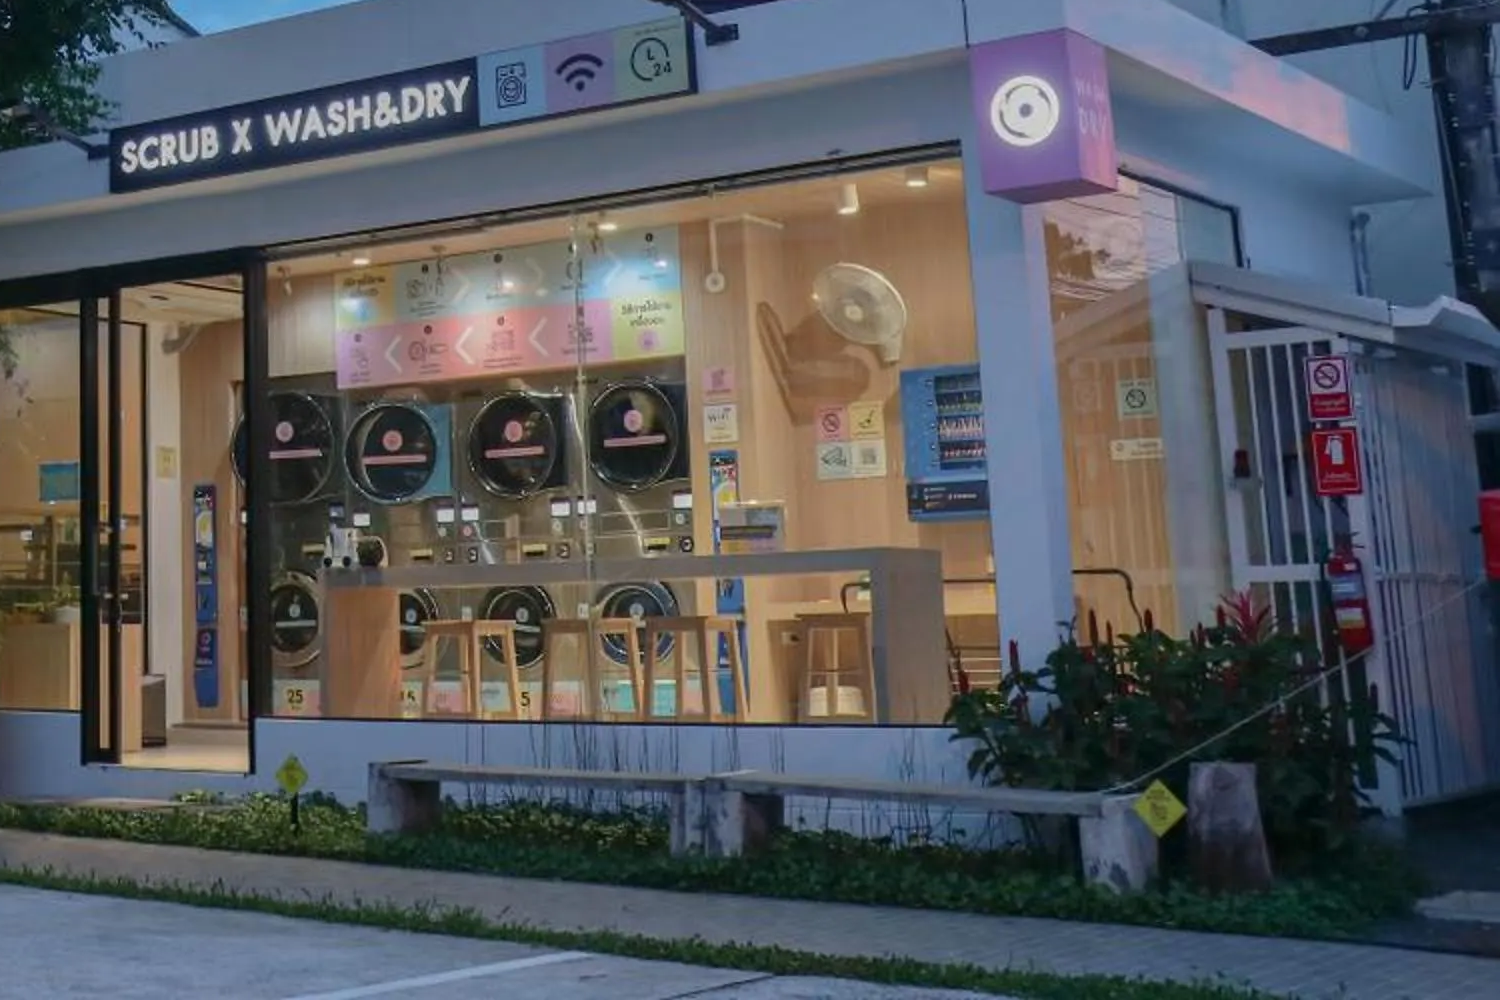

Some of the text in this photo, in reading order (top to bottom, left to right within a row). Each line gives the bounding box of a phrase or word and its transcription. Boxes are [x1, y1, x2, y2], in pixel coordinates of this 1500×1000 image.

[653, 61, 672, 77] 24
[120, 76, 471, 174] SCRUB X WASH&DRY
[286, 689, 304, 704] 25
